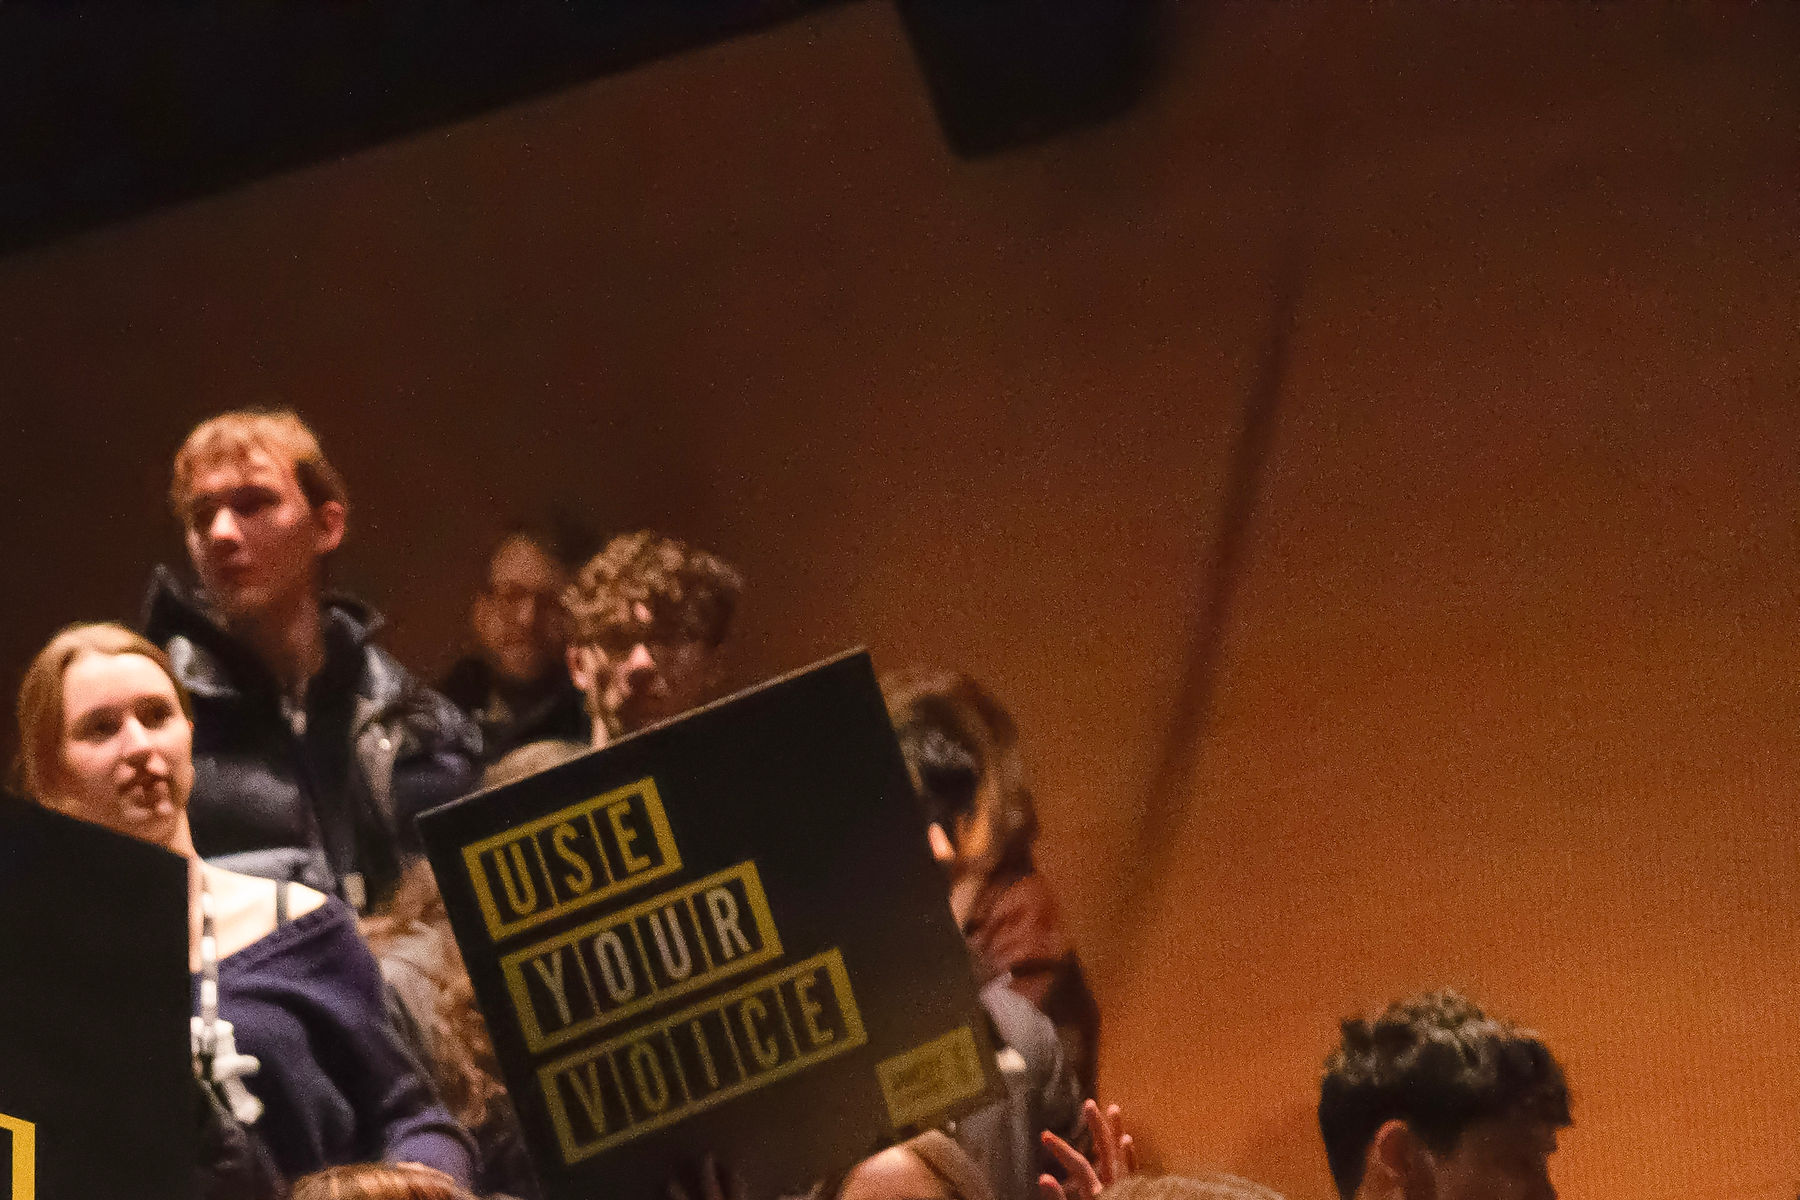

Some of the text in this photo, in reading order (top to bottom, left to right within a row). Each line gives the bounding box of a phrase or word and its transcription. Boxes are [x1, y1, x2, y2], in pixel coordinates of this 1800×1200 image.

[496, 799, 652, 918] USE
[533, 887, 754, 1027] YOUR
[562, 976, 837, 1138] VOICE
